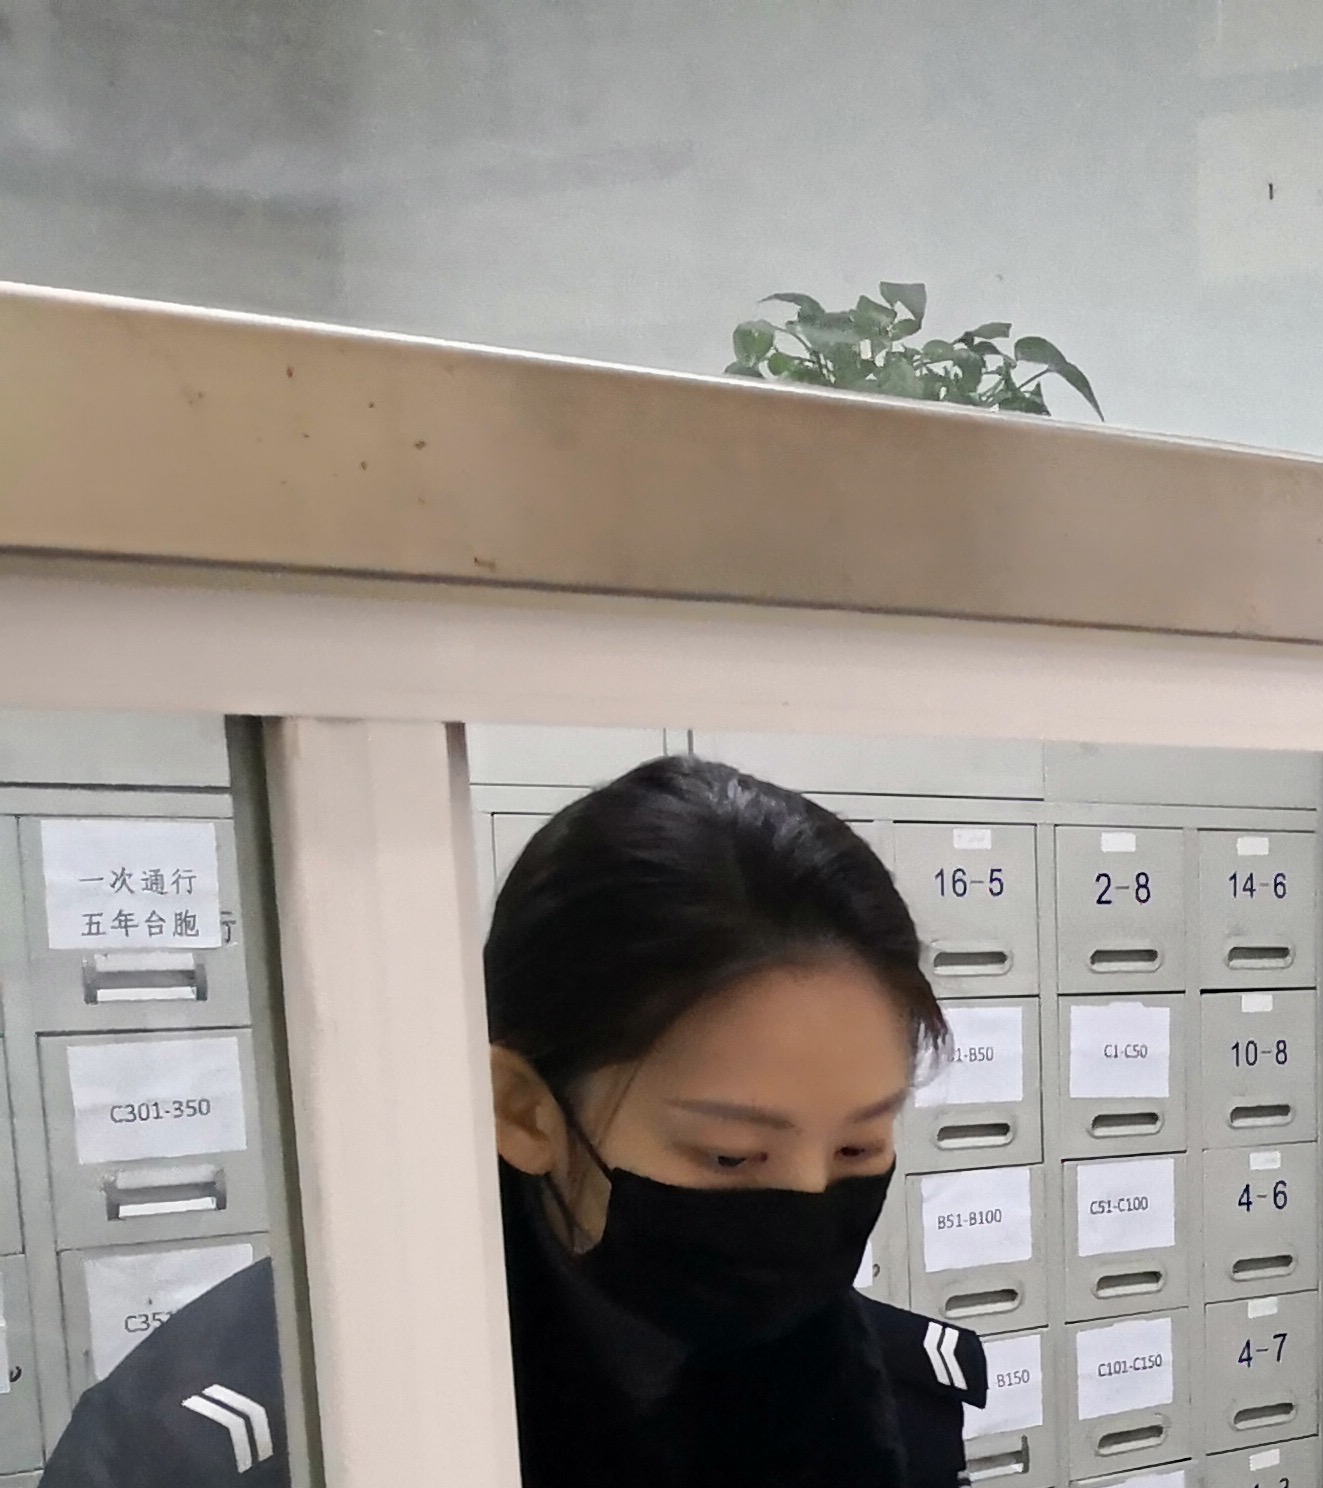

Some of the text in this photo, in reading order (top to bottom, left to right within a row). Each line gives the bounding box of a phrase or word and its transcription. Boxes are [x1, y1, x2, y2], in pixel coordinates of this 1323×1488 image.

[78, 866, 197, 895] 一次通行
[934, 868, 1004, 898] 16-5
[1095, 872, 1151, 905] 2-8
[1228, 872, 1288, 900] 14-6
[81, 909, 200, 938] 五年台胞
[951, 1046, 994, 1063] 1-B50
[1231, 1039, 1288, 1067] 10-8
[109, 1098, 212, 1125] C301-350
[1089, 1195, 1149, 1216] C51-C100
[1237, 1180, 1288, 1212] 4-6
[937, 1208, 1003, 1231] B51-B100
[1237, 1333, 1288, 1369] 4-7
[1097, 1353, 1163, 1378] C101-C150
